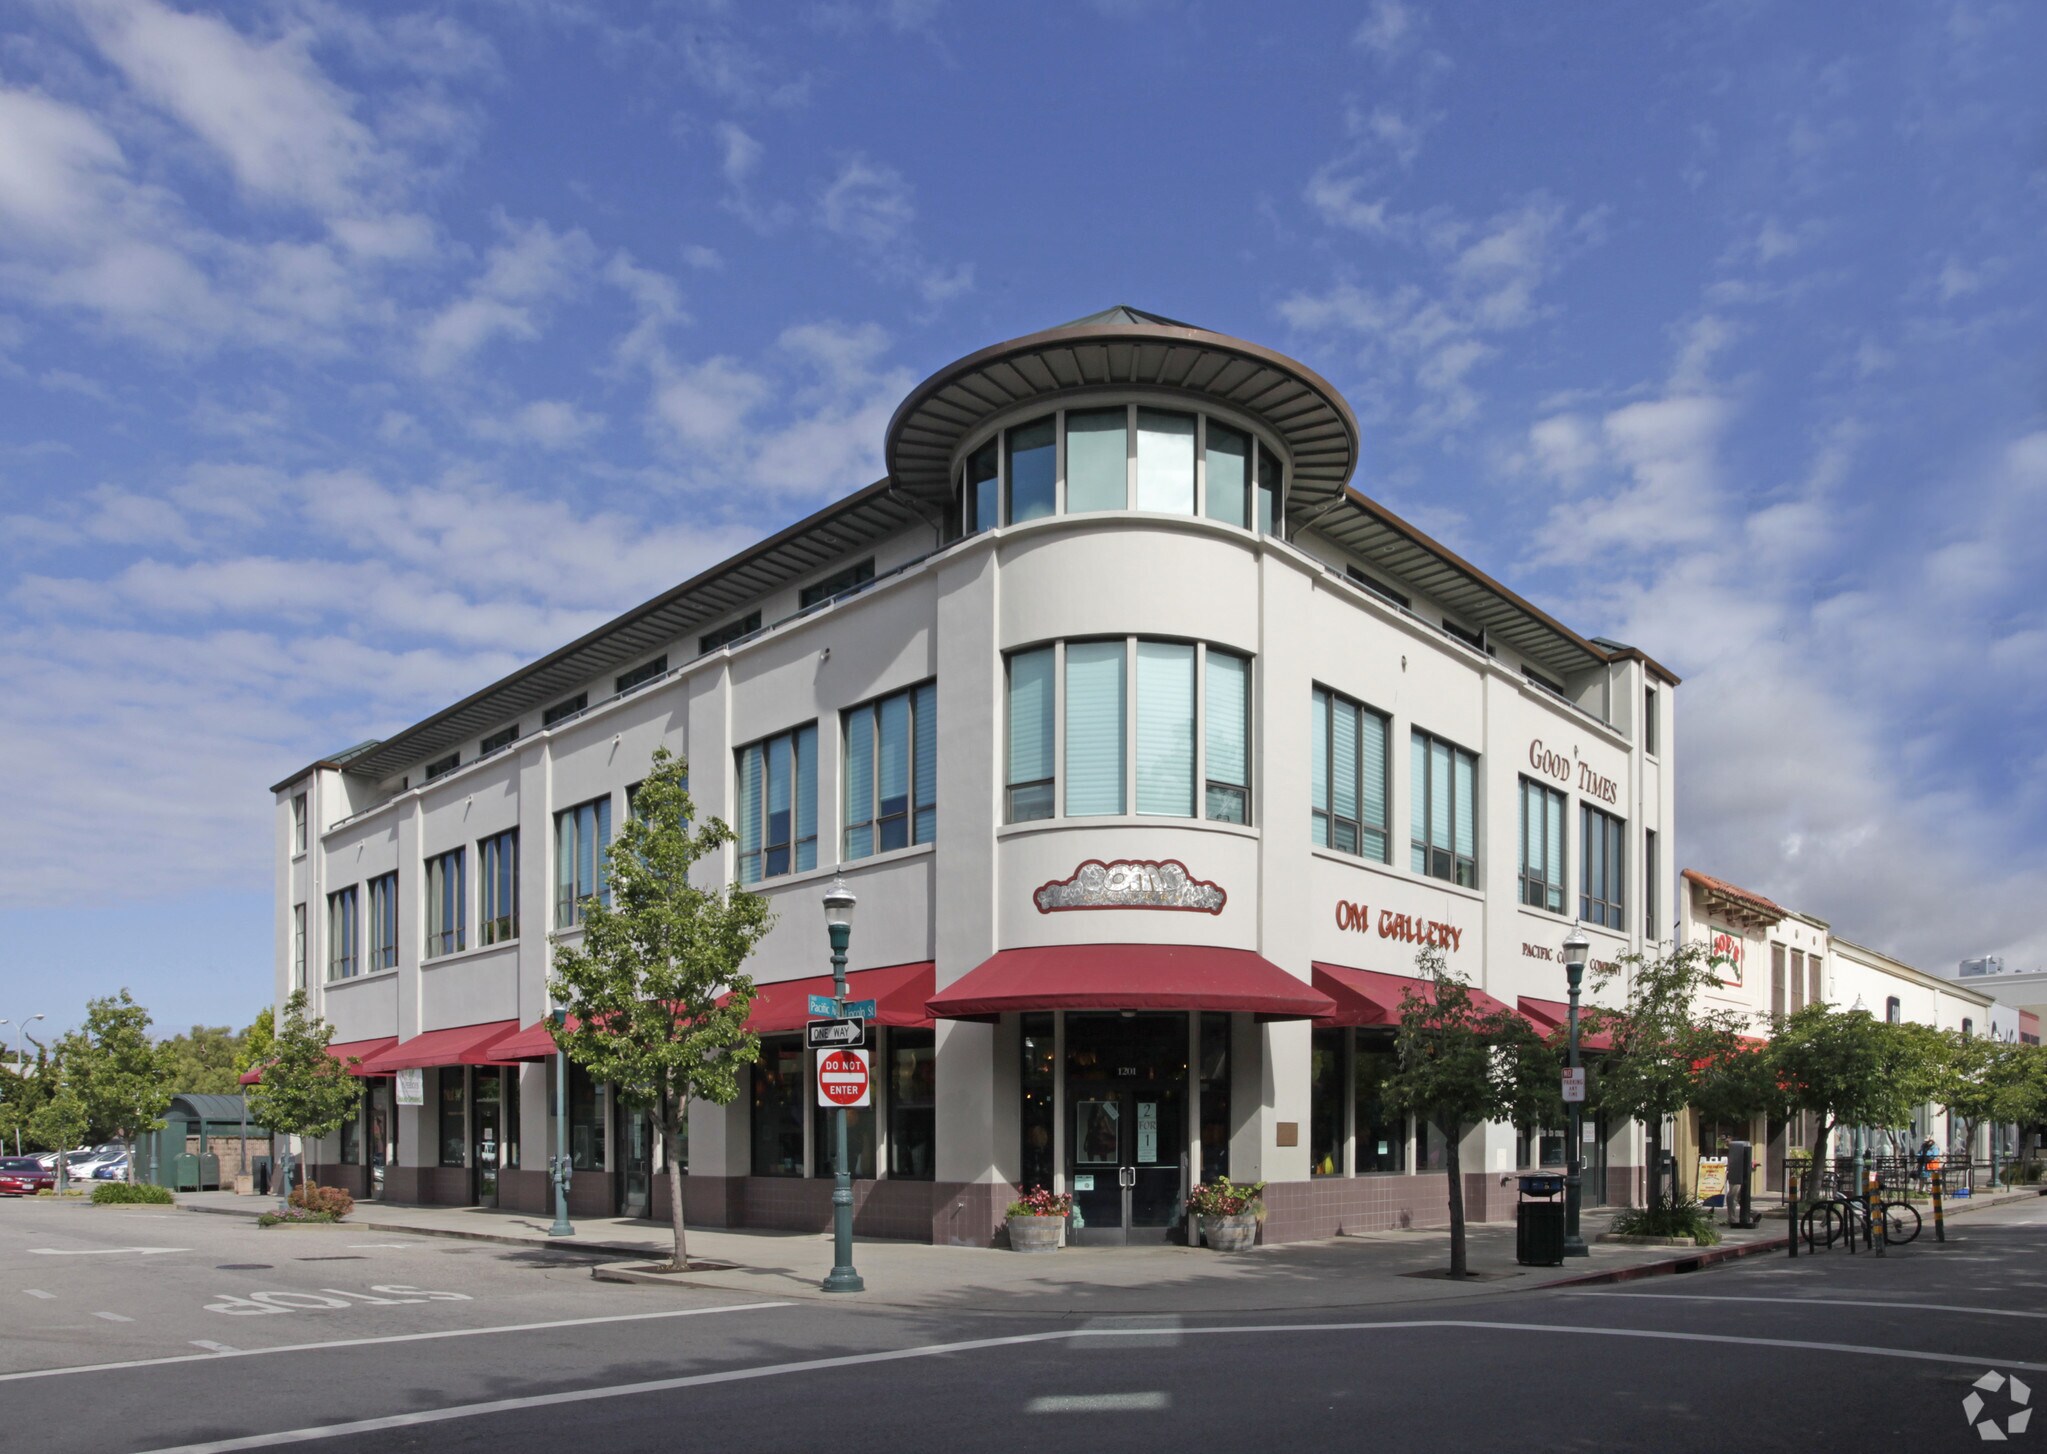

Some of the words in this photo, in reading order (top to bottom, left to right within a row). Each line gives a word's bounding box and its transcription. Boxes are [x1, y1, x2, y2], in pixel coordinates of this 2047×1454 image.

[1529, 739, 1571, 781] GOOD
[1578, 760, 1618, 805] TIMES
[1335, 899, 1369, 934] OM
[1378, 909, 1463, 953] GALLERY
[1522, 942, 1553, 962] PACIFIC
[810, 1000, 830, 1015] Pacific
[867, 1004, 874, 1016] St
[814, 1028, 829, 1040] ONE
[833, 1026, 850, 1038] WAY
[826, 1061, 839, 1070] DO
[842, 1061, 861, 1070] NOT
[1118, 1067, 1136, 1076] 1201
[1563, 1069, 1572, 1078] NO
[830, 1085, 858, 1095] ENTER
[1143, 1104, 1151, 1117] 2
[1139, 1121, 1157, 1130] FOR
[202, 1284, 474, 1316] STOP
